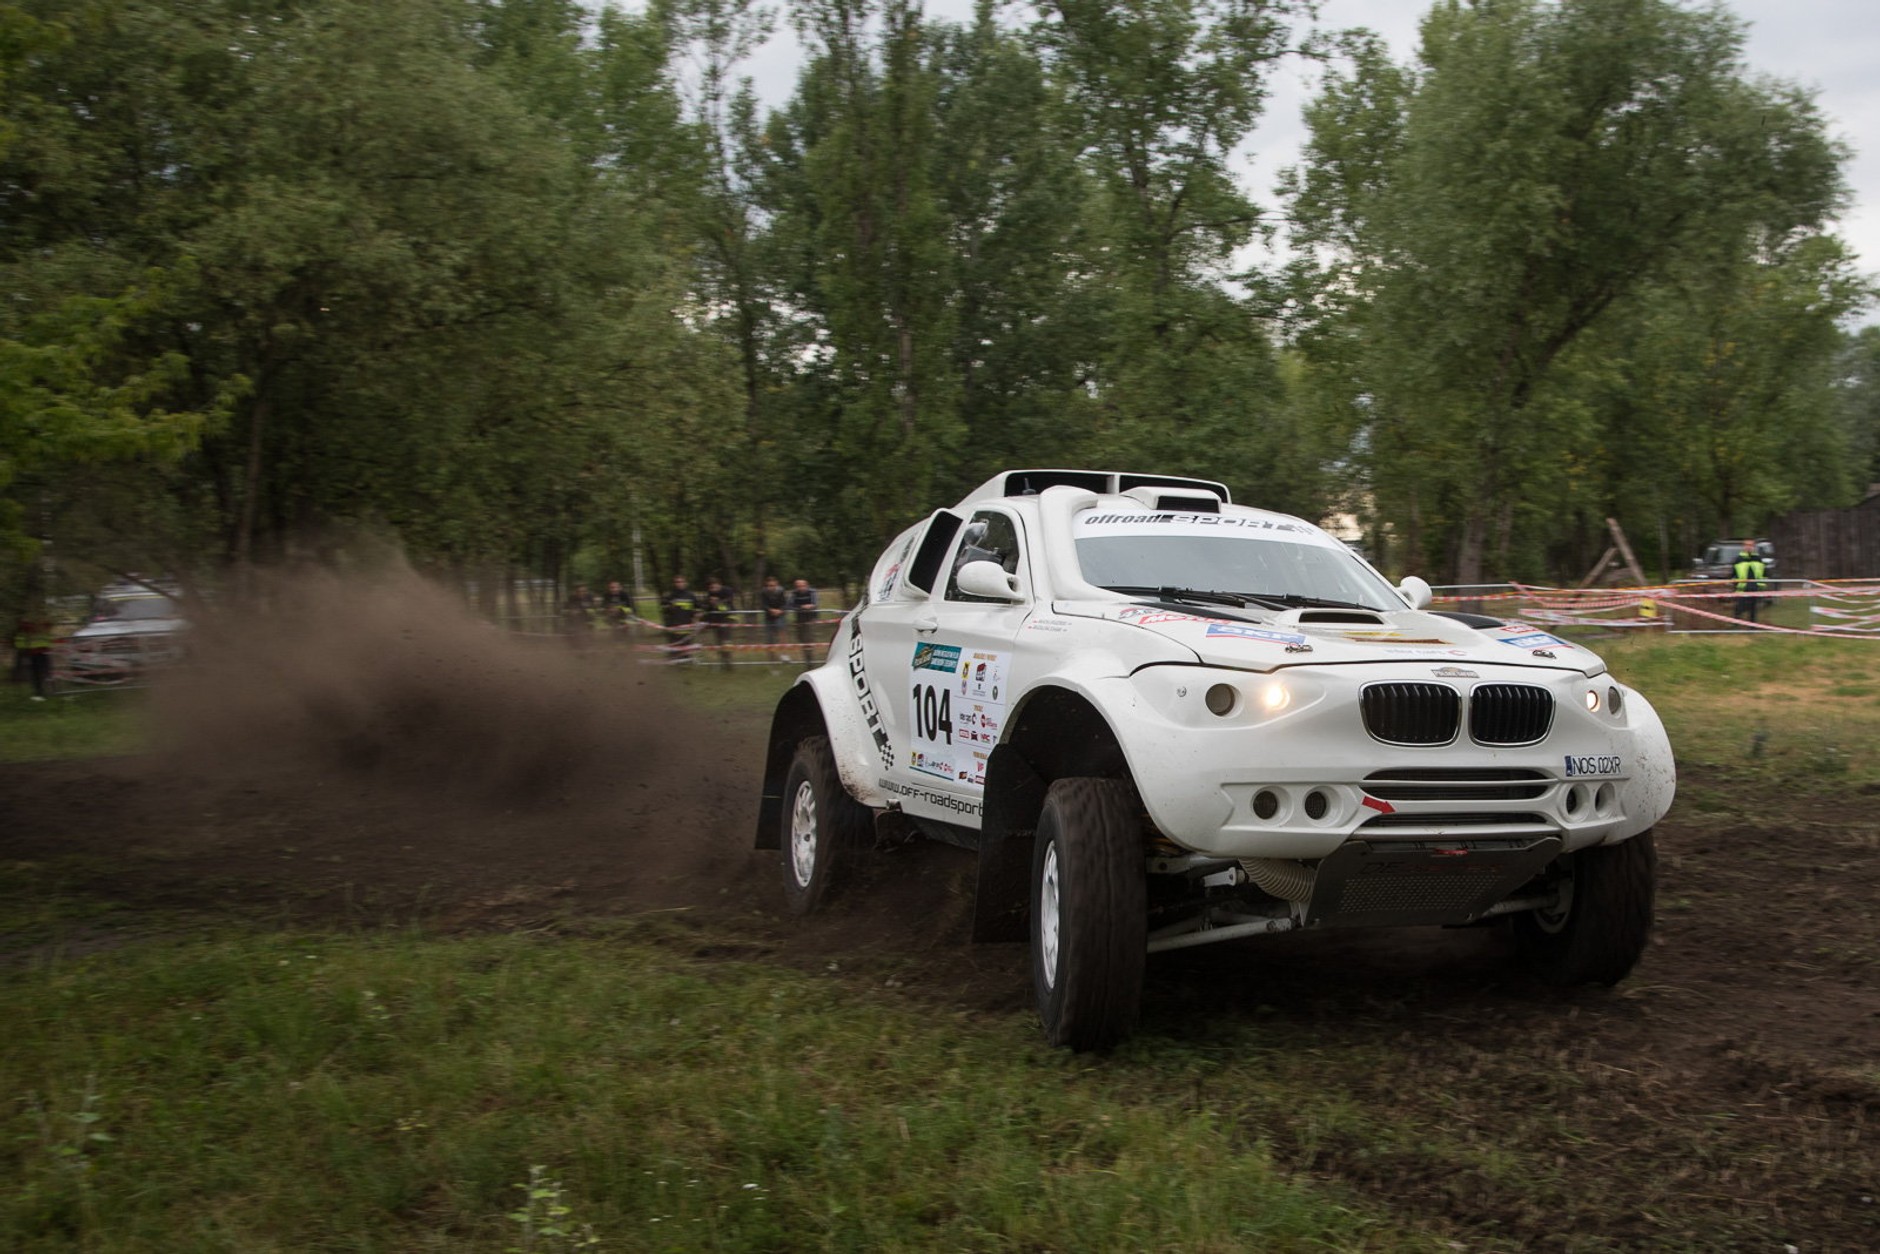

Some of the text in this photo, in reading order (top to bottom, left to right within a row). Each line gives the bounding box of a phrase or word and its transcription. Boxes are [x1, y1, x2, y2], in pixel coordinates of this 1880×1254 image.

[848, 633, 887, 738] SPORT
[912, 683, 953, 746] 104
[1572, 757, 1597, 775] NOS
